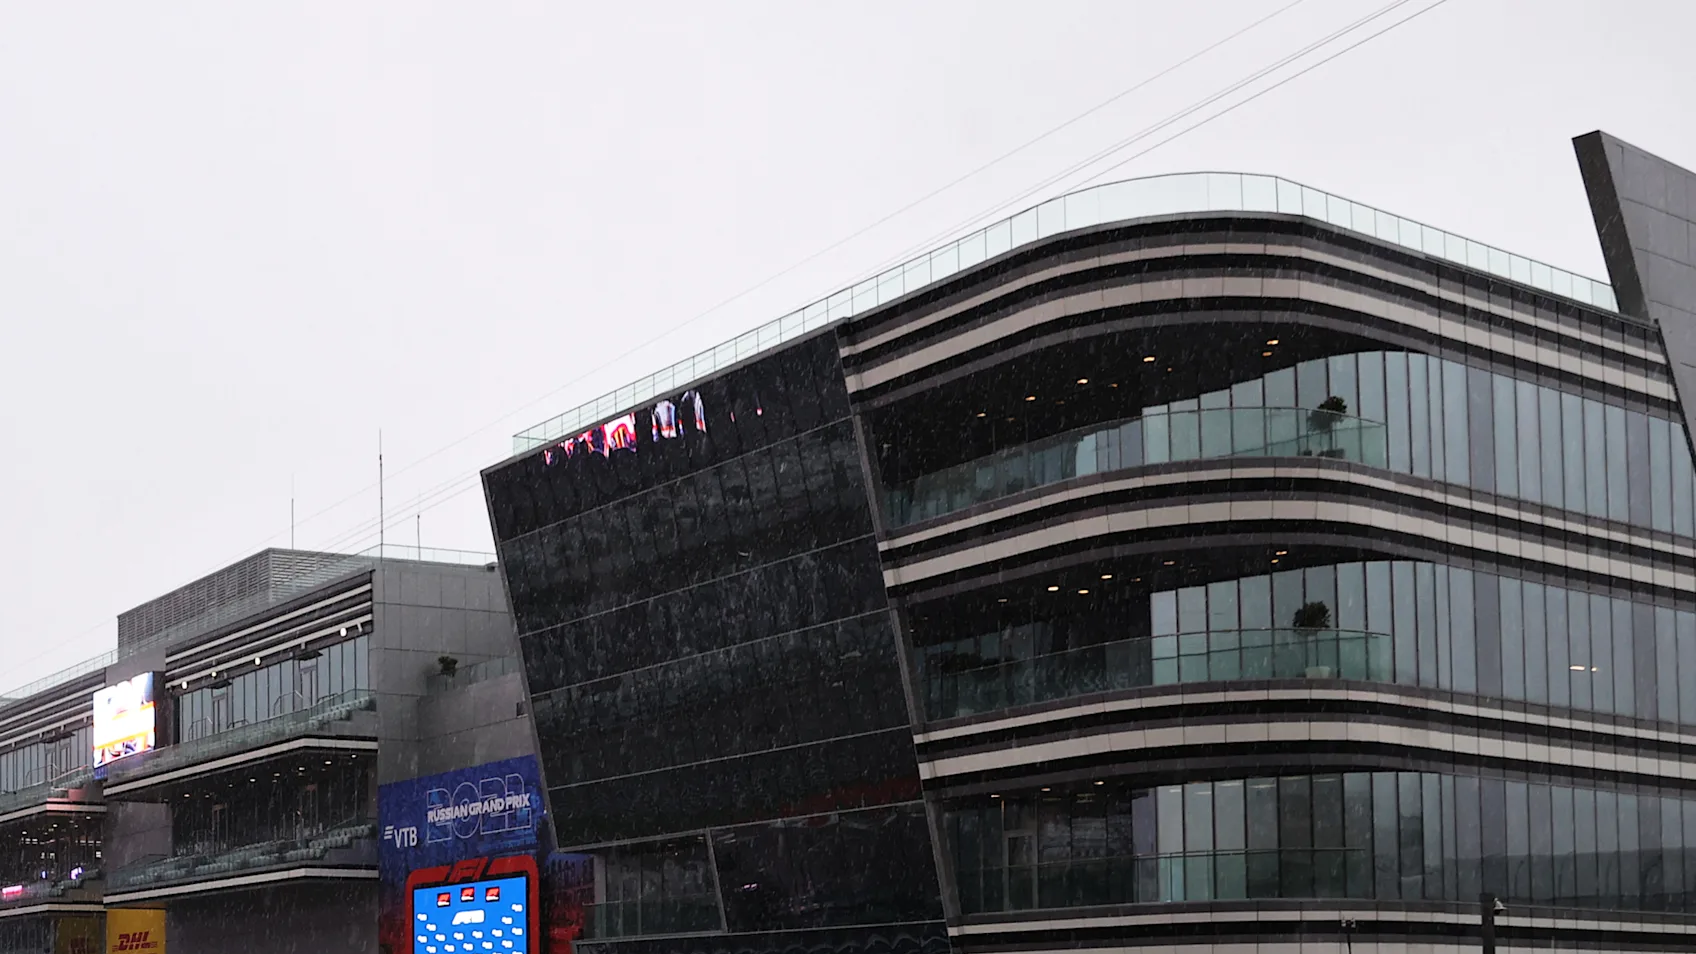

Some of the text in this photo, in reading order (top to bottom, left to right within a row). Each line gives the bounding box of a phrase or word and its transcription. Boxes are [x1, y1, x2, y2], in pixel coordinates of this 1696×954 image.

[427, 793, 531, 823] RUSSIAN GRAND PRIX
[394, 826, 418, 849] VTB
[118, 931, 151, 951] DHL
